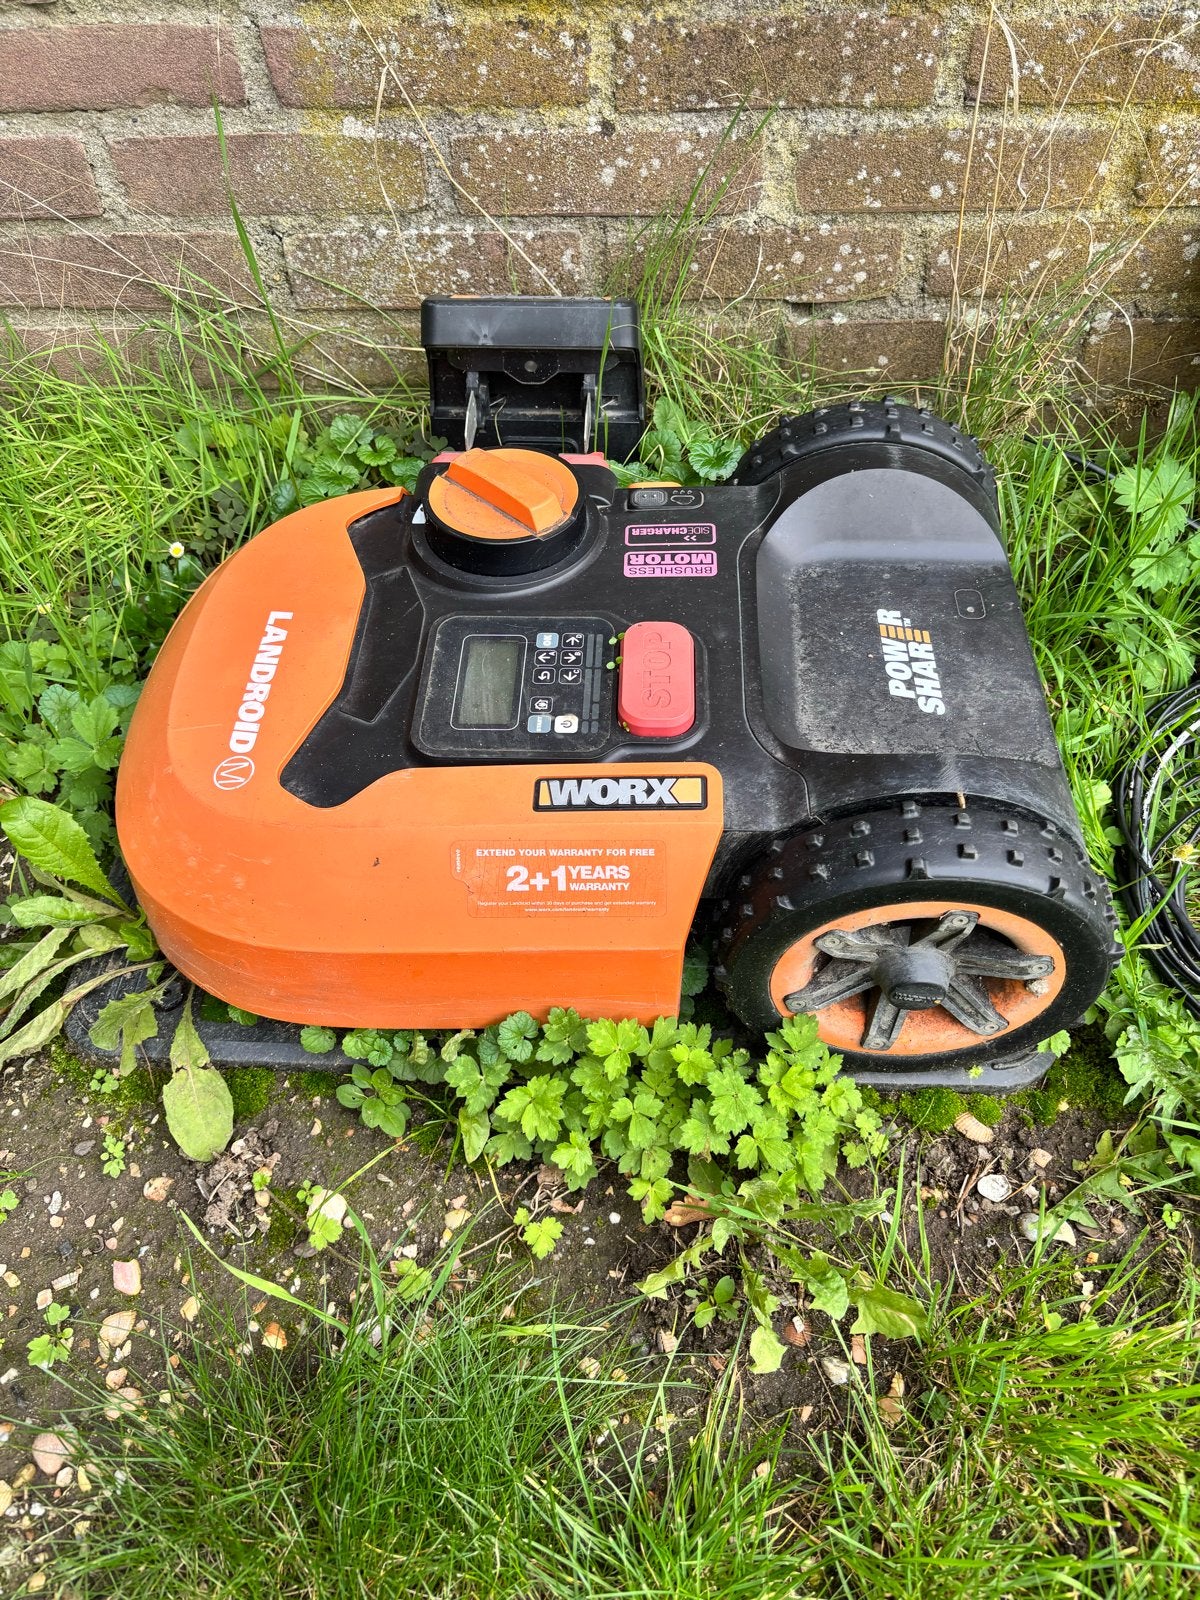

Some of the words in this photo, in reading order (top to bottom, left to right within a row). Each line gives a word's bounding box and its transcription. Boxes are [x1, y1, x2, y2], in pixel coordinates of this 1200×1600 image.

[628, 566, 713, 575] BRUSHLESS
[629, 553, 712, 565] MOTOR
[543, 634, 552, 646] OK
[876, 608, 916, 699] POWER
[229, 611, 294, 753] LANDROID
[642, 632, 671, 708] STOP
[903, 626, 946, 716] SHARE
[215, 758, 253, 787] M
[549, 777, 678, 806] WORX
[476, 848, 516, 857] EXTEND
[518, 848, 547, 857] YOUR
[548, 848, 604, 857] WARRANTY
[606, 848, 627, 857] FOR
[629, 848, 655, 857] FREE
[506, 864, 567, 892] 2+1
[567, 865, 631, 880] YEARS
[569, 882, 630, 892] WARRANTY
